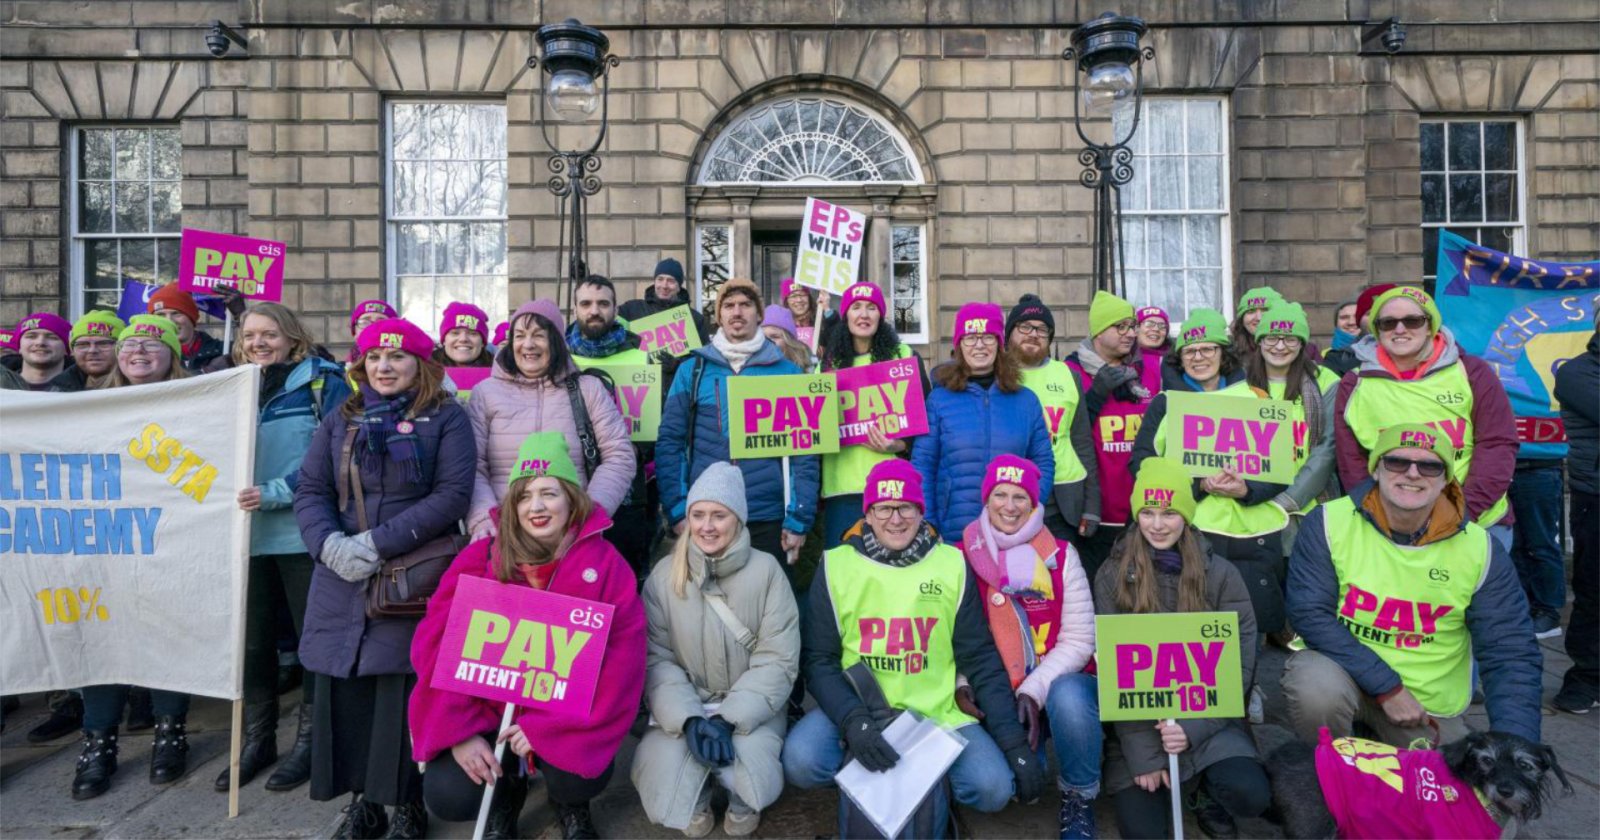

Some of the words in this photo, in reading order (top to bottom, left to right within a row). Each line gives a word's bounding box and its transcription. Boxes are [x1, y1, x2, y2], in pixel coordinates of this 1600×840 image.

[809, 199, 863, 243] EPs
[258, 243, 281, 256] eis
[808, 233, 851, 260] WITH
[194, 247, 275, 284] PAY
[799, 251, 851, 296] EIS
[456, 314, 479, 328] PAY
[672, 309, 688, 320] eis
[965, 318, 989, 332] PAY
[1270, 320, 1295, 330] PAY
[380, 333, 404, 345] PAY
[639, 320, 686, 352] PAY
[1184, 325, 1206, 341] PAY
[632, 370, 656, 384] eis
[889, 363, 914, 379] eis
[808, 378, 832, 394] eis
[1046, 382, 1065, 394] eis
[838, 380, 910, 424] PAY
[1436, 390, 1465, 405] eis
[743, 396, 826, 434] PAY
[1259, 405, 1287, 421] eis
[1099, 413, 1144, 442] PA
[1183, 414, 1280, 457] PAY
[1400, 430, 1436, 446] PAY
[744, 428, 820, 450] ATTENT10N
[127, 422, 219, 503] SSTA
[521, 459, 551, 471] PAY
[997, 466, 1025, 480] PAY
[0, 453, 122, 500] LEITH
[877, 480, 905, 494] PAY
[1144, 488, 1175, 502] PAY
[919, 579, 943, 596] eis
[36, 586, 110, 625] 10%
[1340, 583, 1455, 635] PAY
[569, 606, 605, 629] eis
[858, 617, 939, 655] PAY
[1201, 620, 1232, 638] eis
[461, 609, 593, 680] PAY
[1115, 641, 1225, 689] PAY
[455, 660, 569, 702] ATTENT10N
[1118, 685, 1218, 712] ATTENT10N
[1420, 766, 1442, 803] eis
